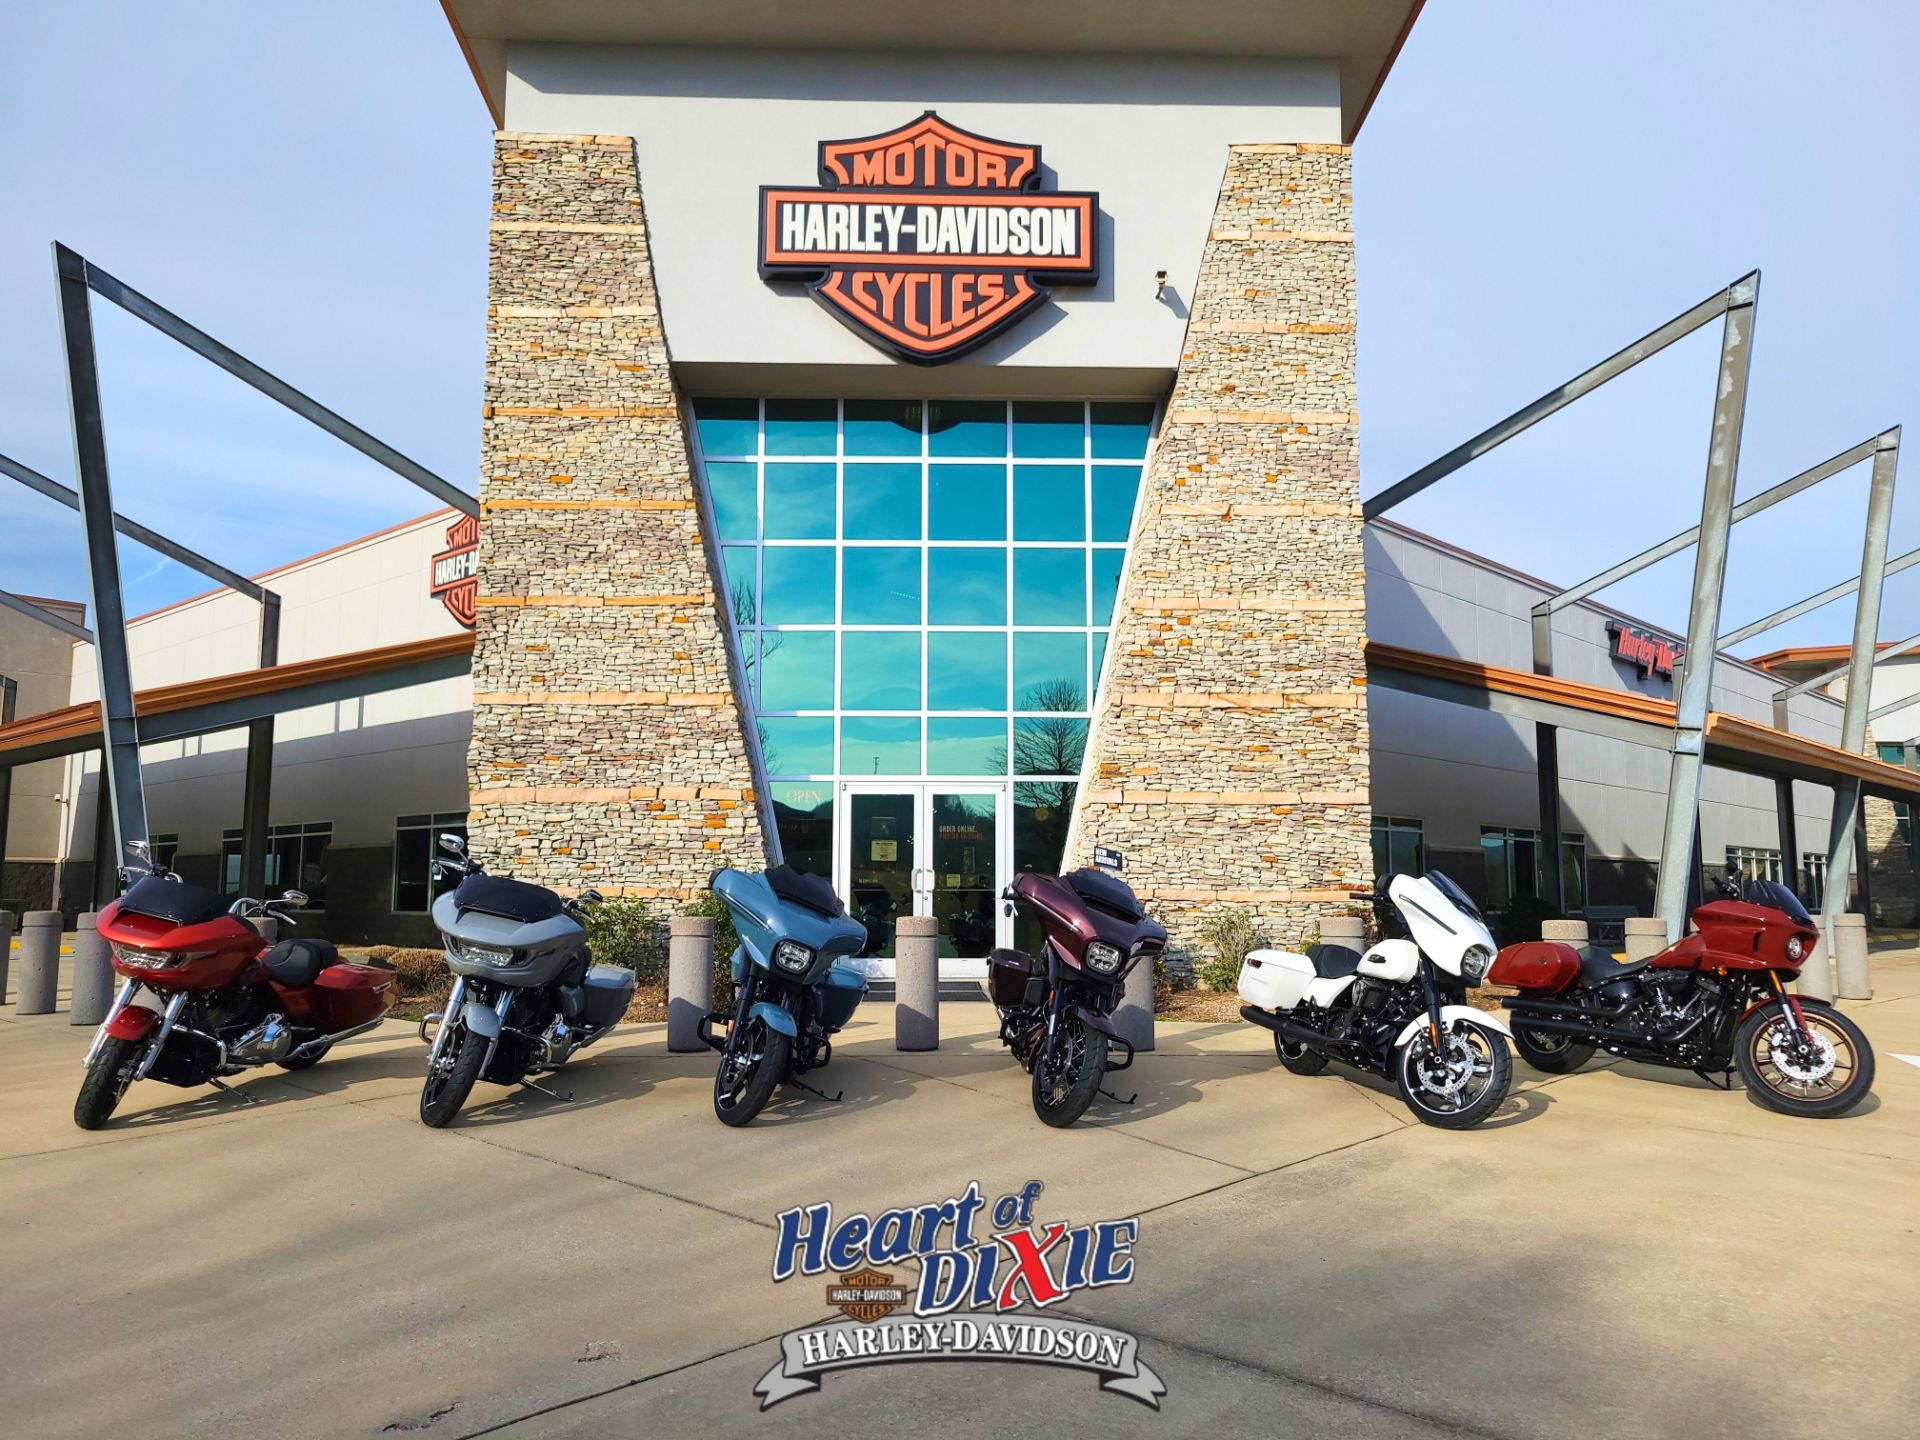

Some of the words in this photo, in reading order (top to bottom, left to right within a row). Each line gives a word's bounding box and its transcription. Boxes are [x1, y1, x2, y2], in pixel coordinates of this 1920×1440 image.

[853, 131, 1007, 188] MOTOR
[781, 203, 1077, 257] HARLEY-DAVIDSON
[852, 272, 1005, 337] CYCLES
[453, 517, 480, 547] MOT
[787, 789, 822, 803] OPEN
